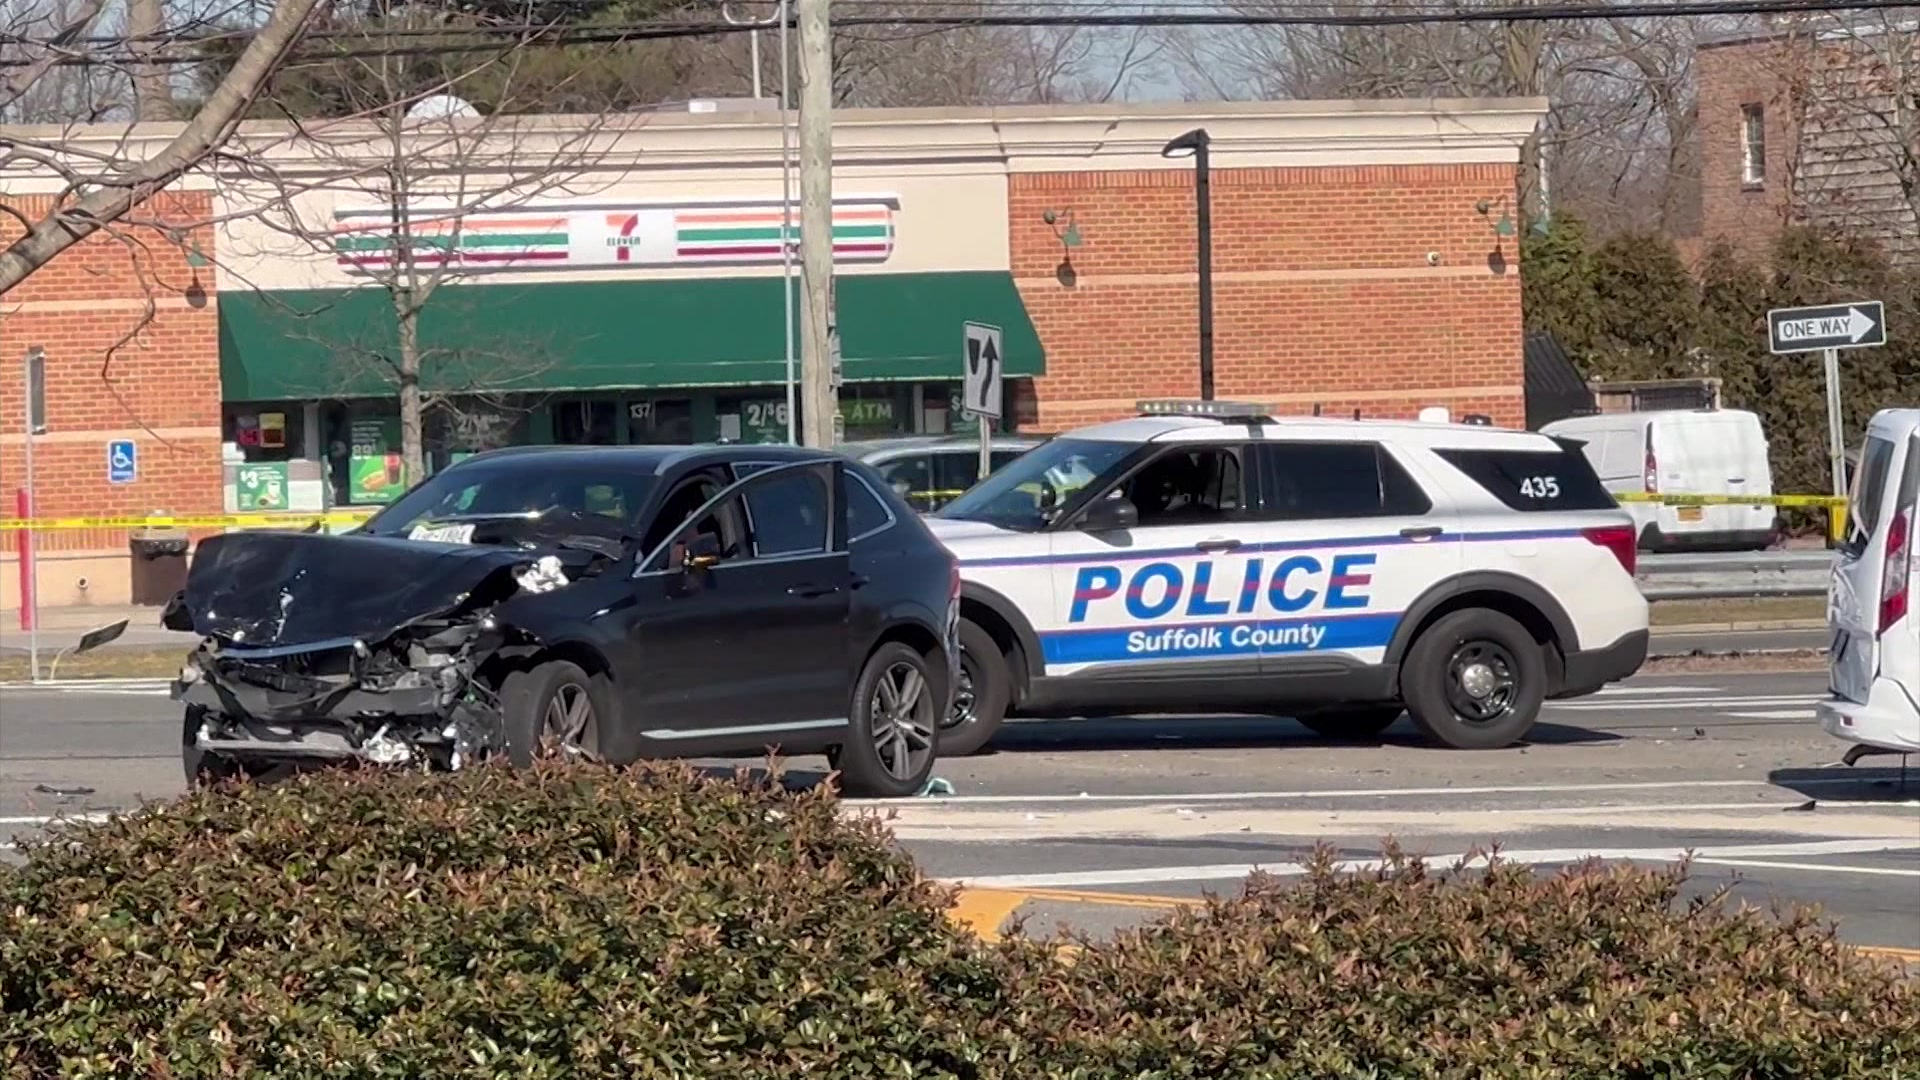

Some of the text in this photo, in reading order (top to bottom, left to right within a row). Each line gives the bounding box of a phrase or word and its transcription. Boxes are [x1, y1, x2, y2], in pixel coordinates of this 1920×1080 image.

[606, 213, 638, 261] 7
[1783, 317, 1852, 338] ONE WAY
[851, 403, 892, 420] ATM
[1520, 476, 1560, 498] 435
[1068, 553, 1377, 623] POLICE
[1127, 624, 1326, 653] Suffolk County
